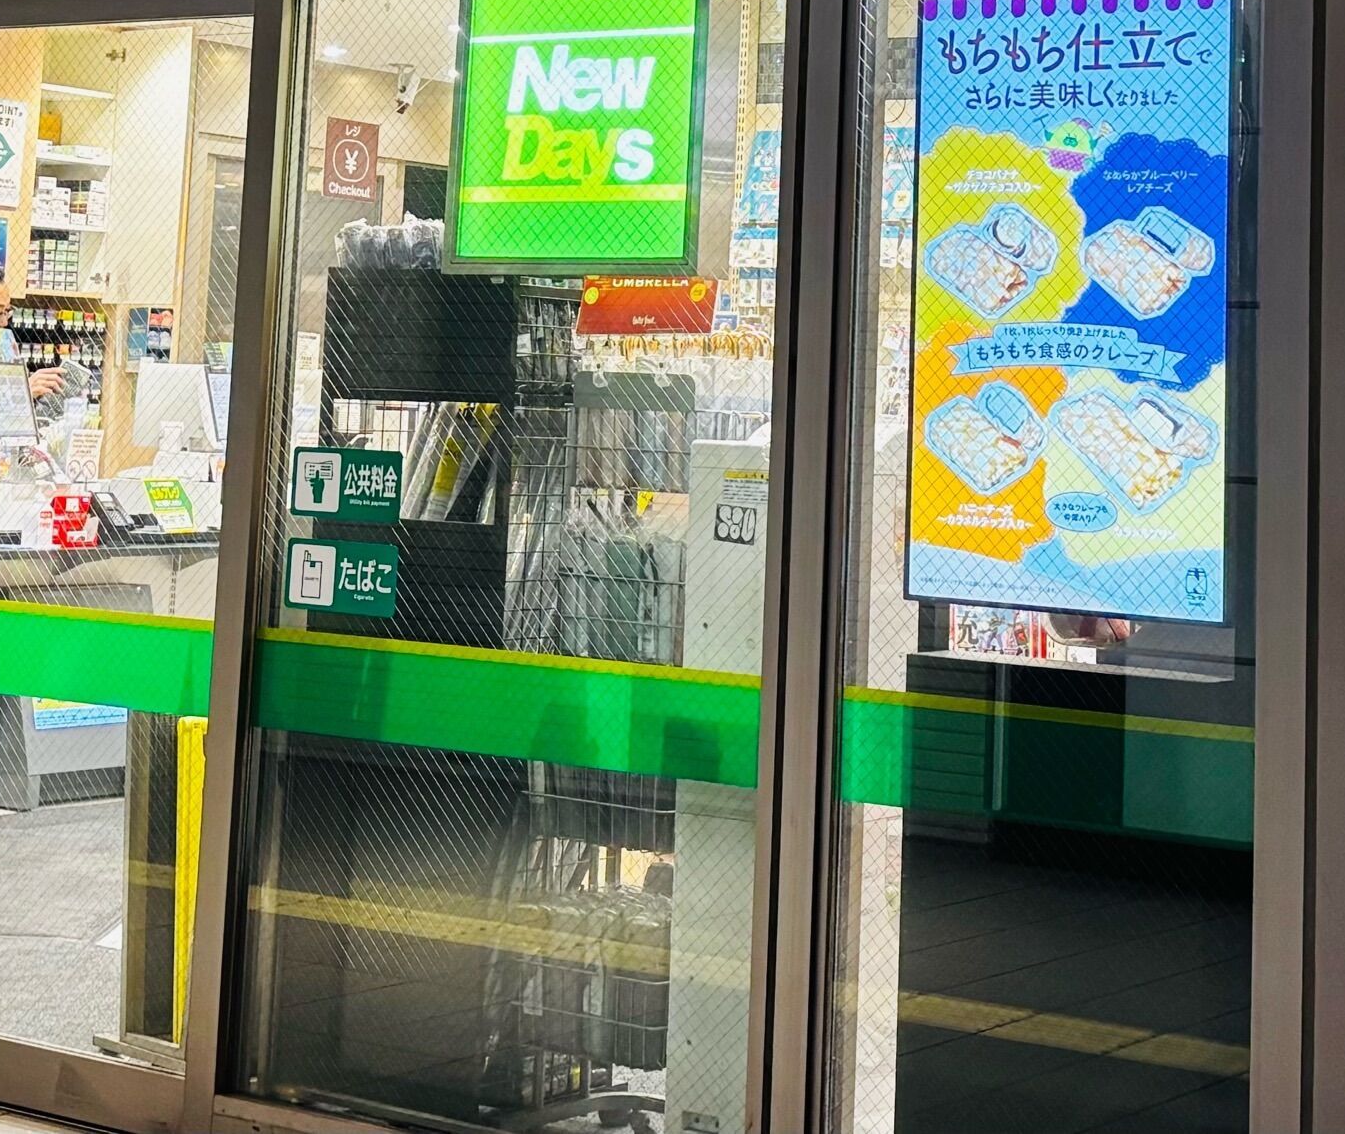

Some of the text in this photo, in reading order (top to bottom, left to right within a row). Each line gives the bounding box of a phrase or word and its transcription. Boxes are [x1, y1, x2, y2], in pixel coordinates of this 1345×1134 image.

[937, 20, 1213, 75] もちもち仕立てで
[507, 44, 656, 112] New
[965, 79, 1179, 111] さらに美味しくなりました
[345, 124, 361, 137] レジ
[502, 115, 655, 188] Days
[328, 181, 371, 199] Checkout
[1127, 182, 1174, 194] レアチーズ
[976, 341, 1158, 366] もちもち食感のクレープ
[344, 463, 398, 498] 公共料金
[338, 558, 392, 594] たばこ
